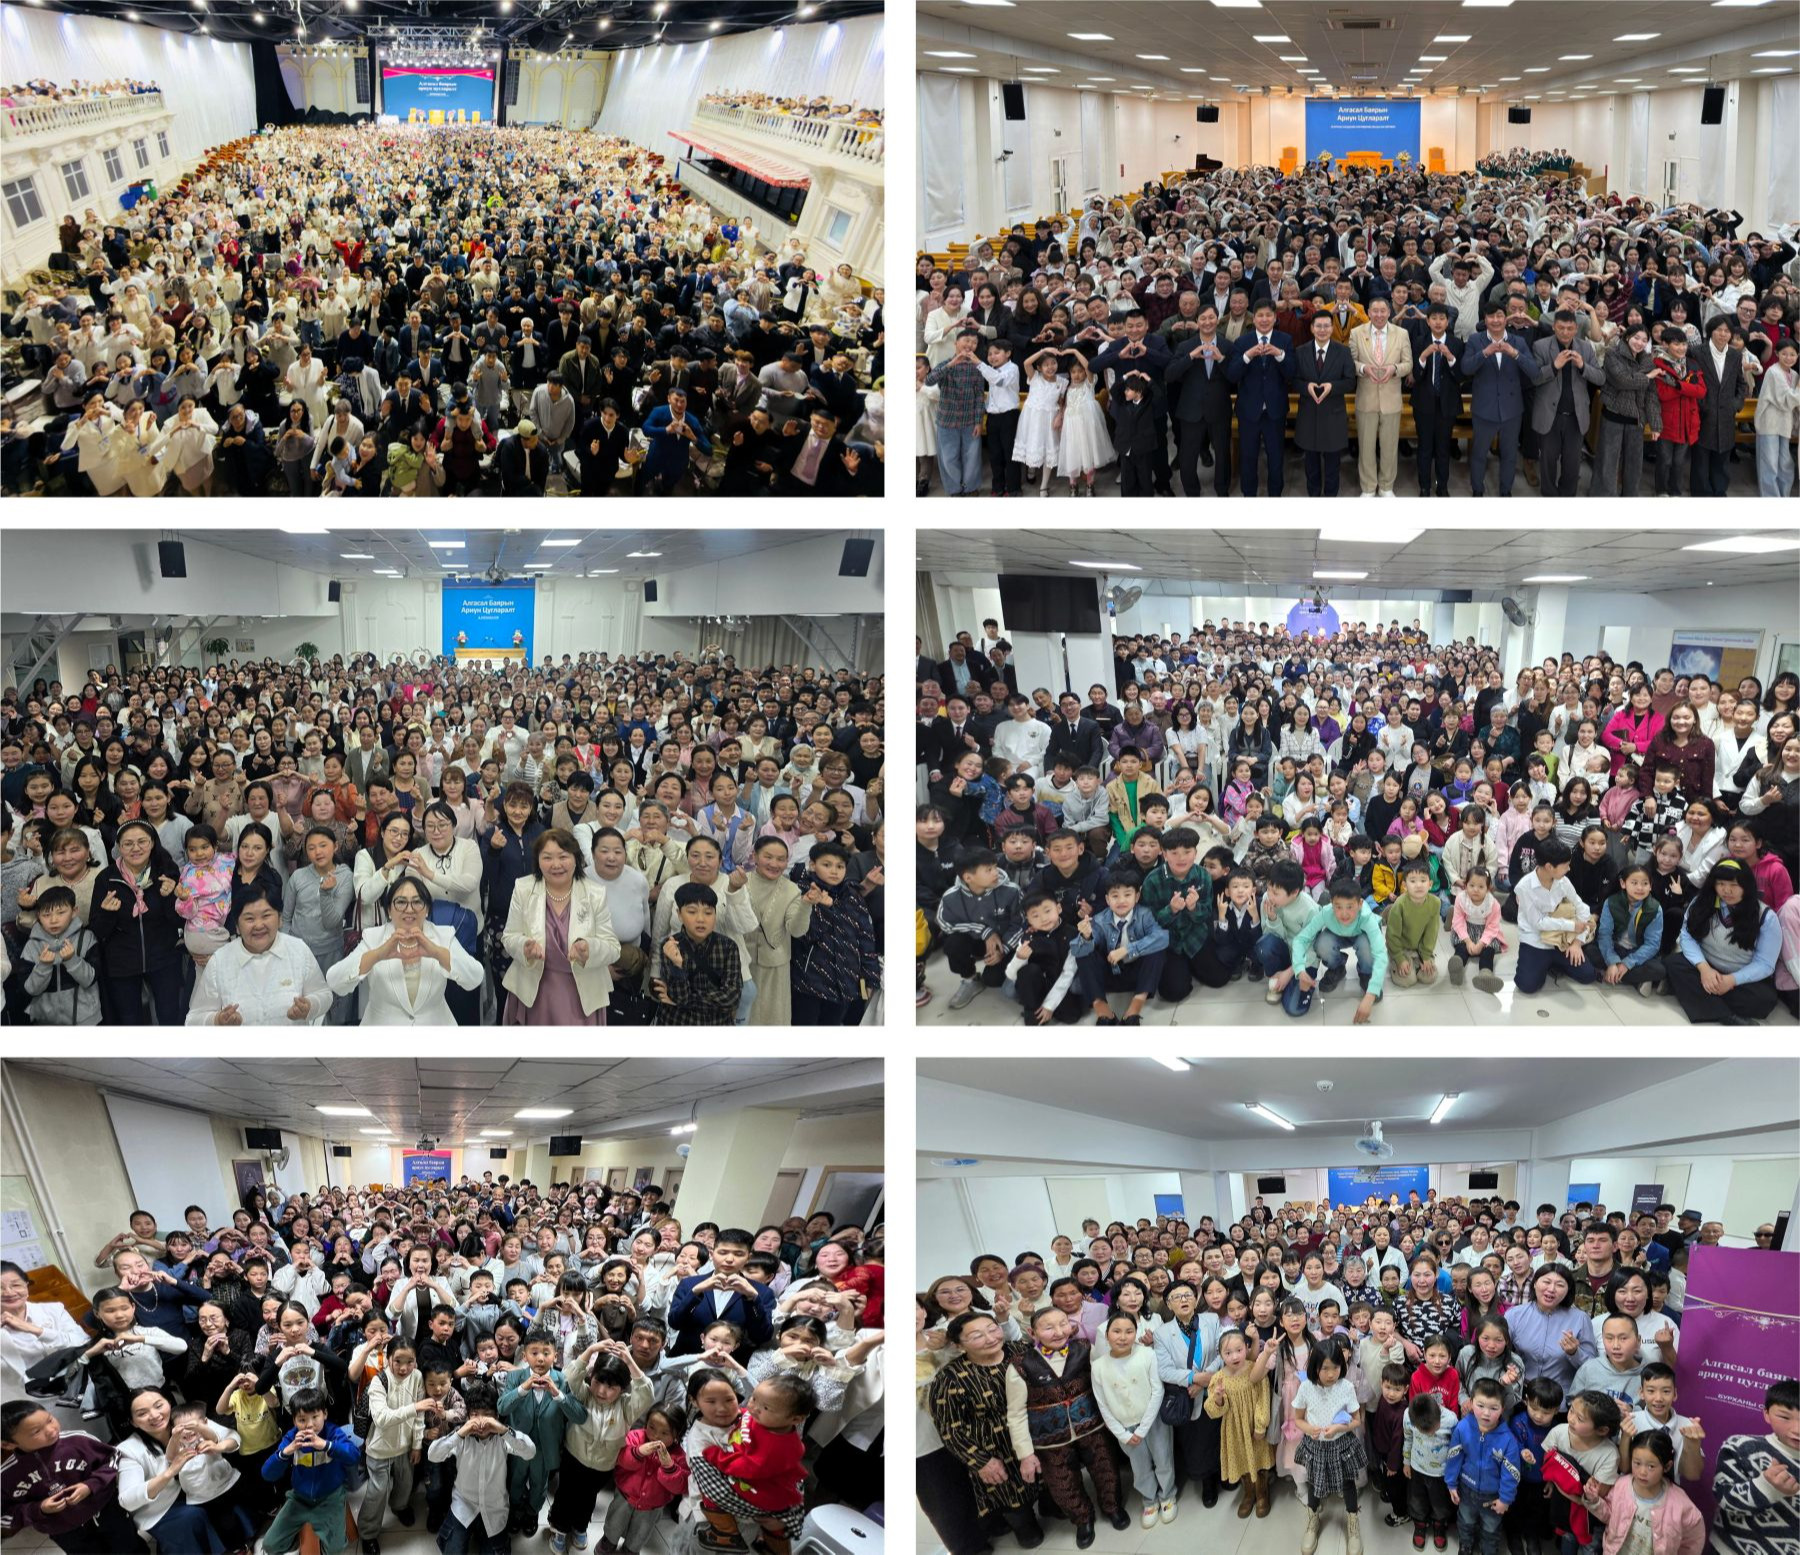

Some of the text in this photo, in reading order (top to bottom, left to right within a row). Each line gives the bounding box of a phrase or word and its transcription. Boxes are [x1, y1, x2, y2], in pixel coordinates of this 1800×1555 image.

[1337, 114, 1389, 122] Ариун Цугларалт
[1701, 1358, 1754, 1375] Алгасал
[1698, 1370, 1734, 1383] ариун
[1717, 1393, 1757, 1407] БУРХАНЫ
